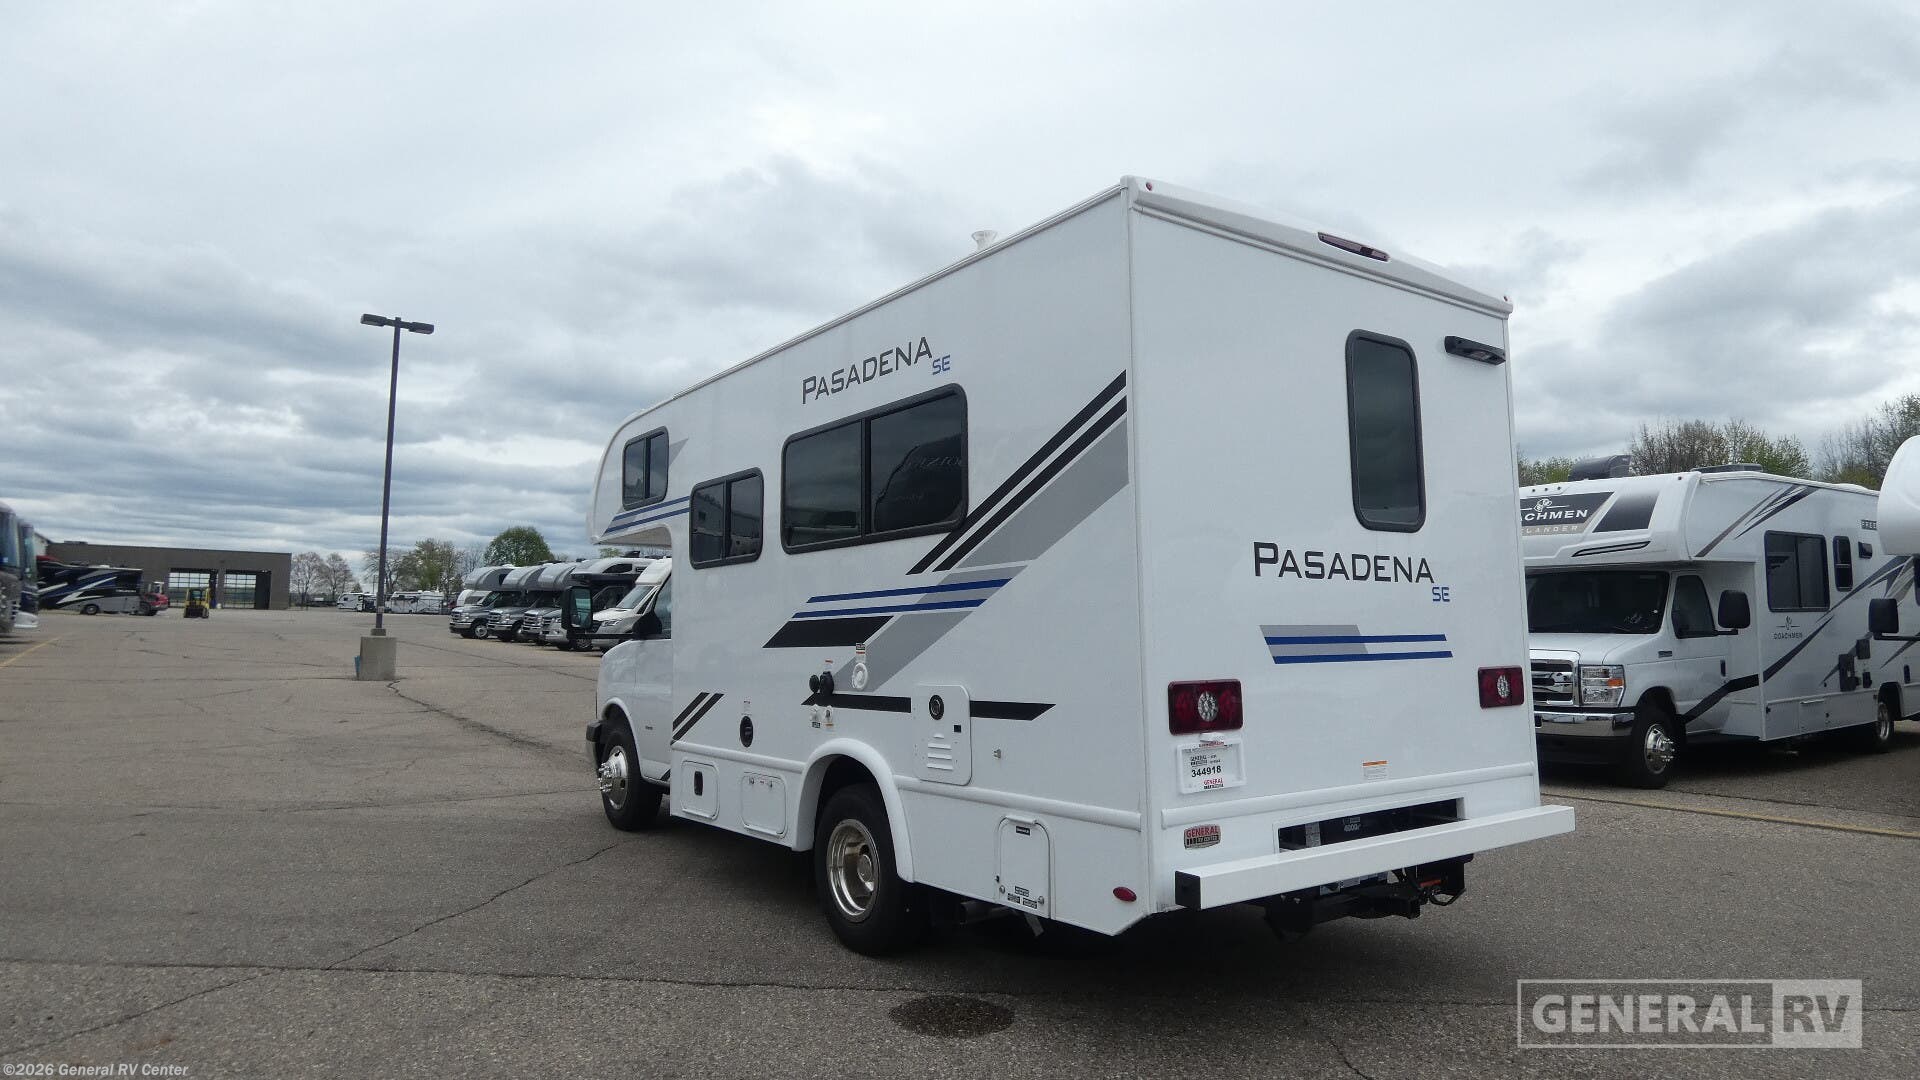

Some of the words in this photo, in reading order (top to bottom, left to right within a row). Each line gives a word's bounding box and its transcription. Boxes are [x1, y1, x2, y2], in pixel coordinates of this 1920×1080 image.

[803, 337, 932, 404] PASADENA
[932, 355, 951, 375] SE
[1520, 509, 1588, 522] CHMEN
[1254, 542, 1434, 583] PASADENA
[1432, 587, 1450, 602] SE
[1186, 825, 1218, 838] GENERAL
